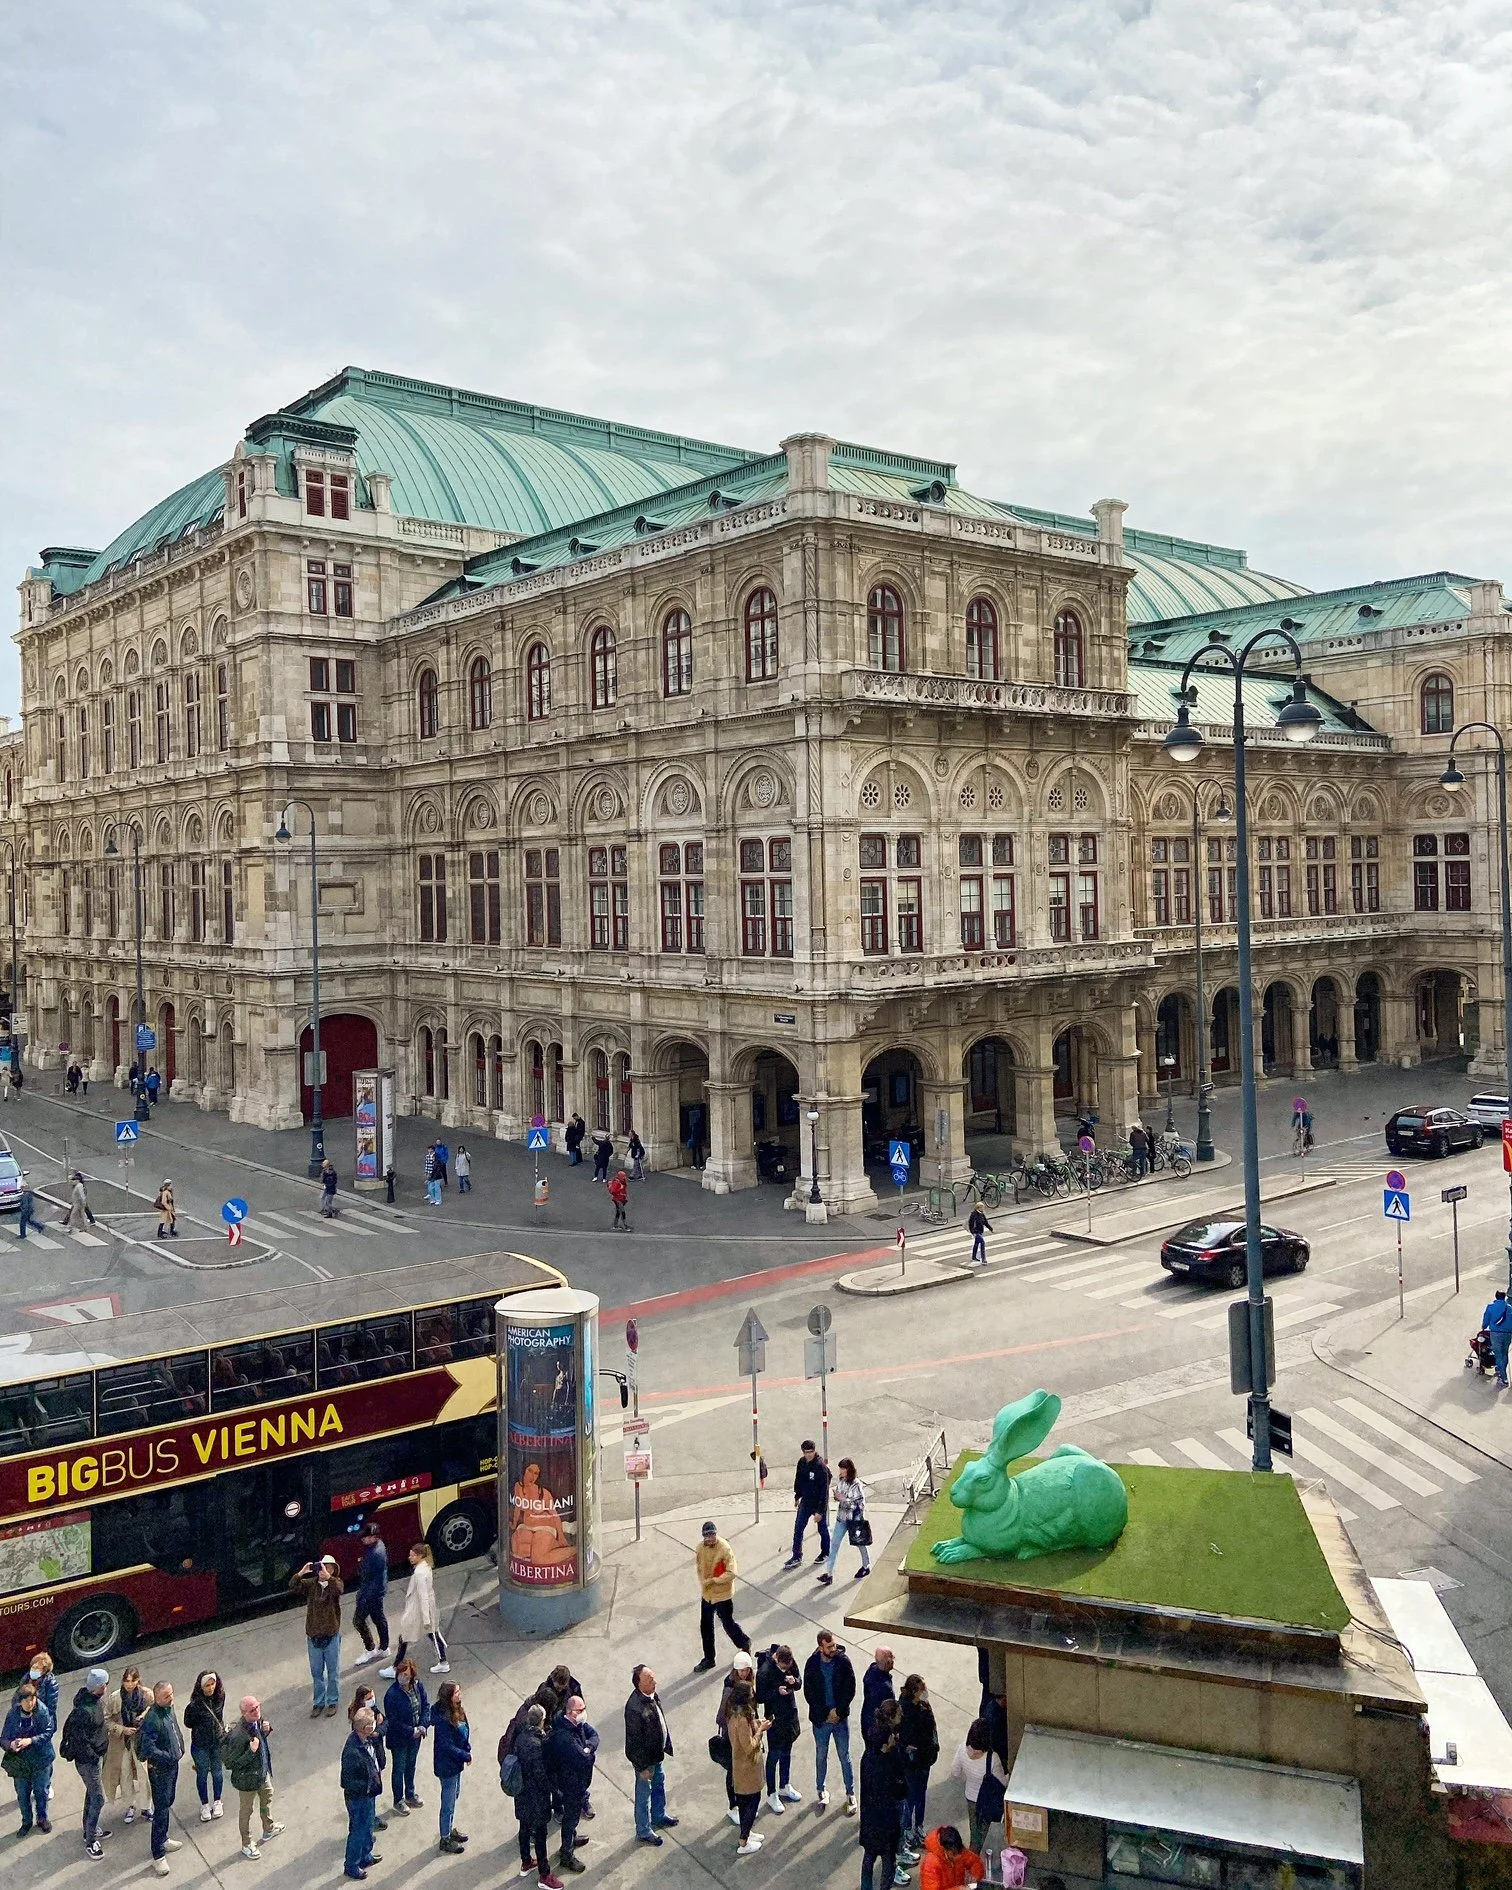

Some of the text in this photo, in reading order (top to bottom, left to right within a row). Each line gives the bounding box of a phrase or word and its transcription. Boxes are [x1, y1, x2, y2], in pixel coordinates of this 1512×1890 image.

[508, 1325, 551, 1338] AMERICAN
[508, 1334, 572, 1348] PHOTOGRAPHY
[192, 1403, 344, 1464] VIENNA
[509, 1493, 574, 1511] MODIGLIANI
[509, 1560, 575, 1579] ALBERTINA
